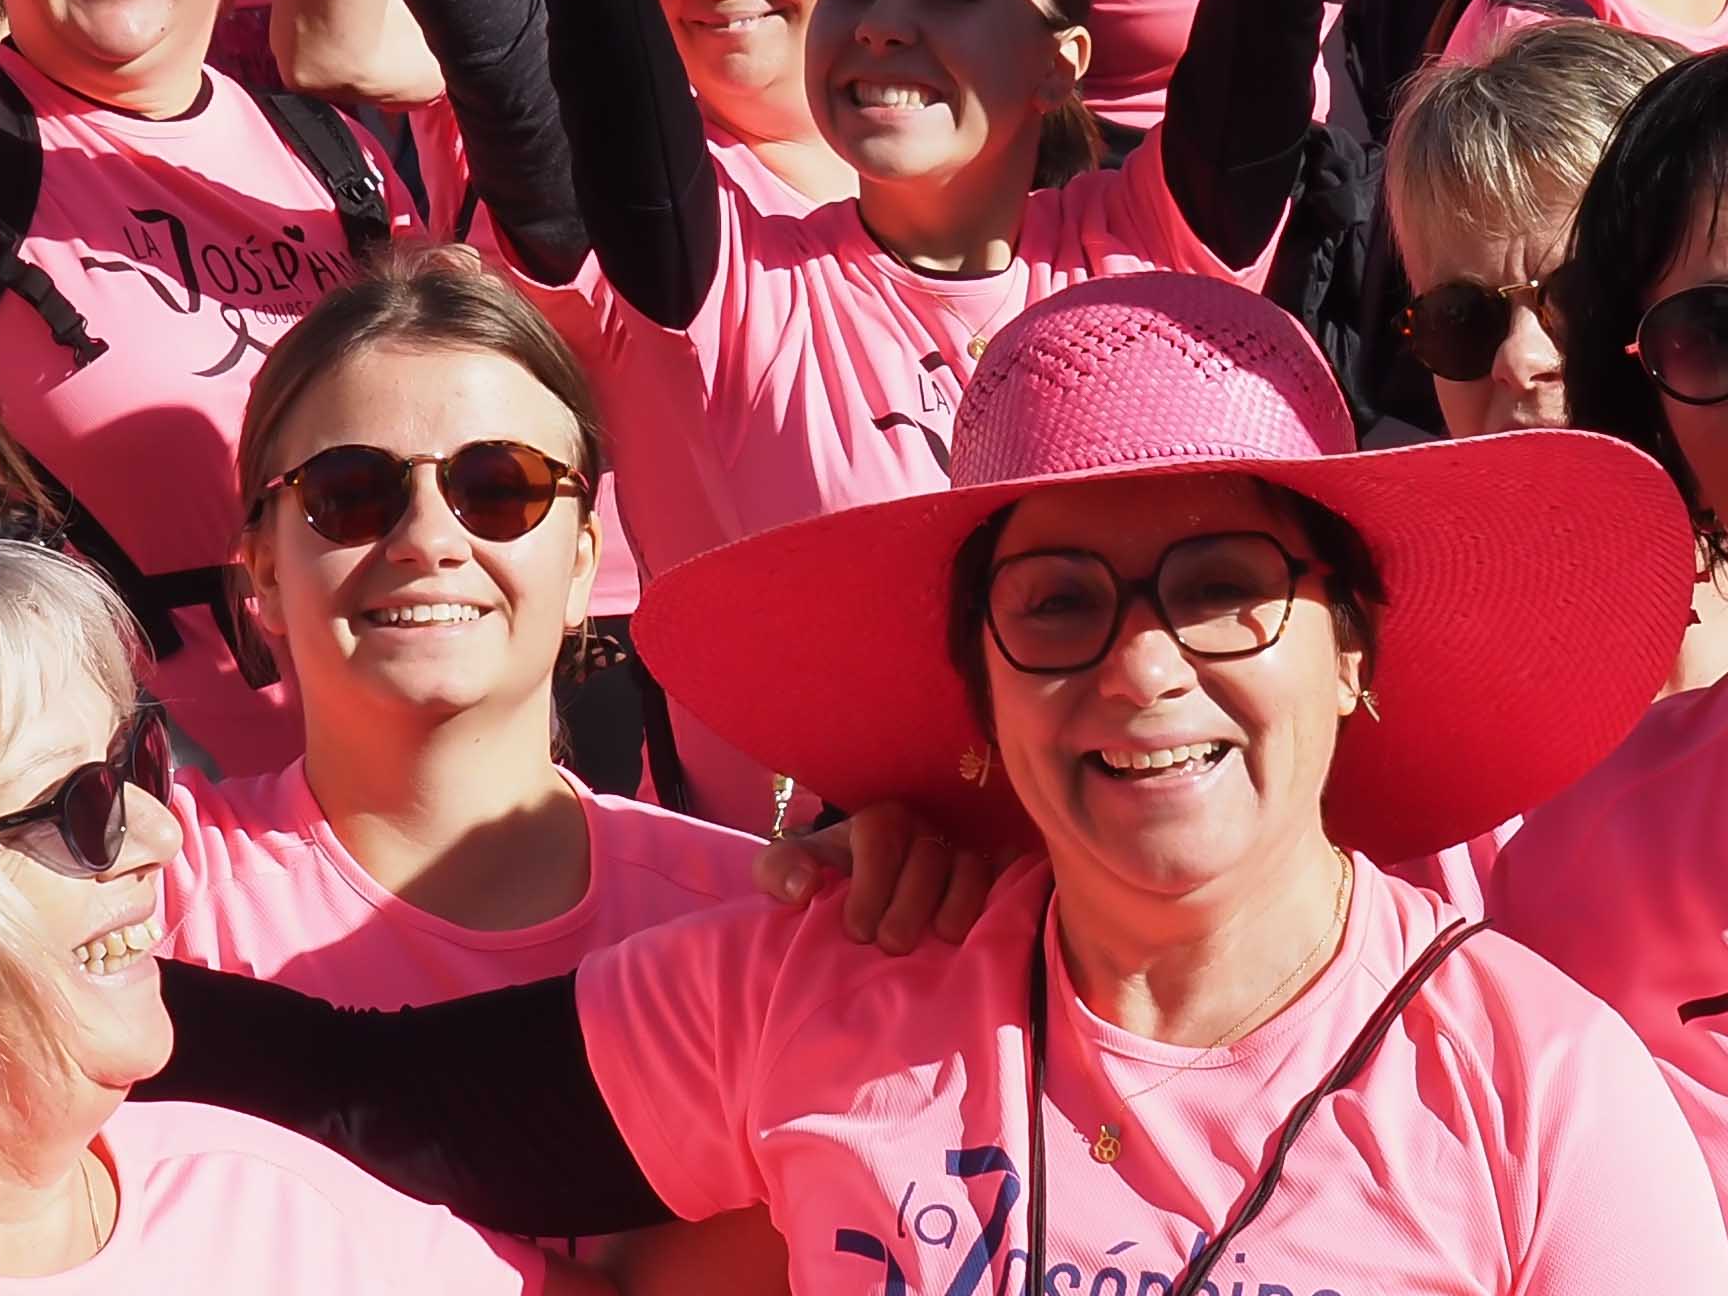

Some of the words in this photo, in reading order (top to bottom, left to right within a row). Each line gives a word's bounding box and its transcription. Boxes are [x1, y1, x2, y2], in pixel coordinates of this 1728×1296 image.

[122, 225, 162, 260] LA
[918, 371, 950, 414] LA
[896, 1180, 960, 1251] la
